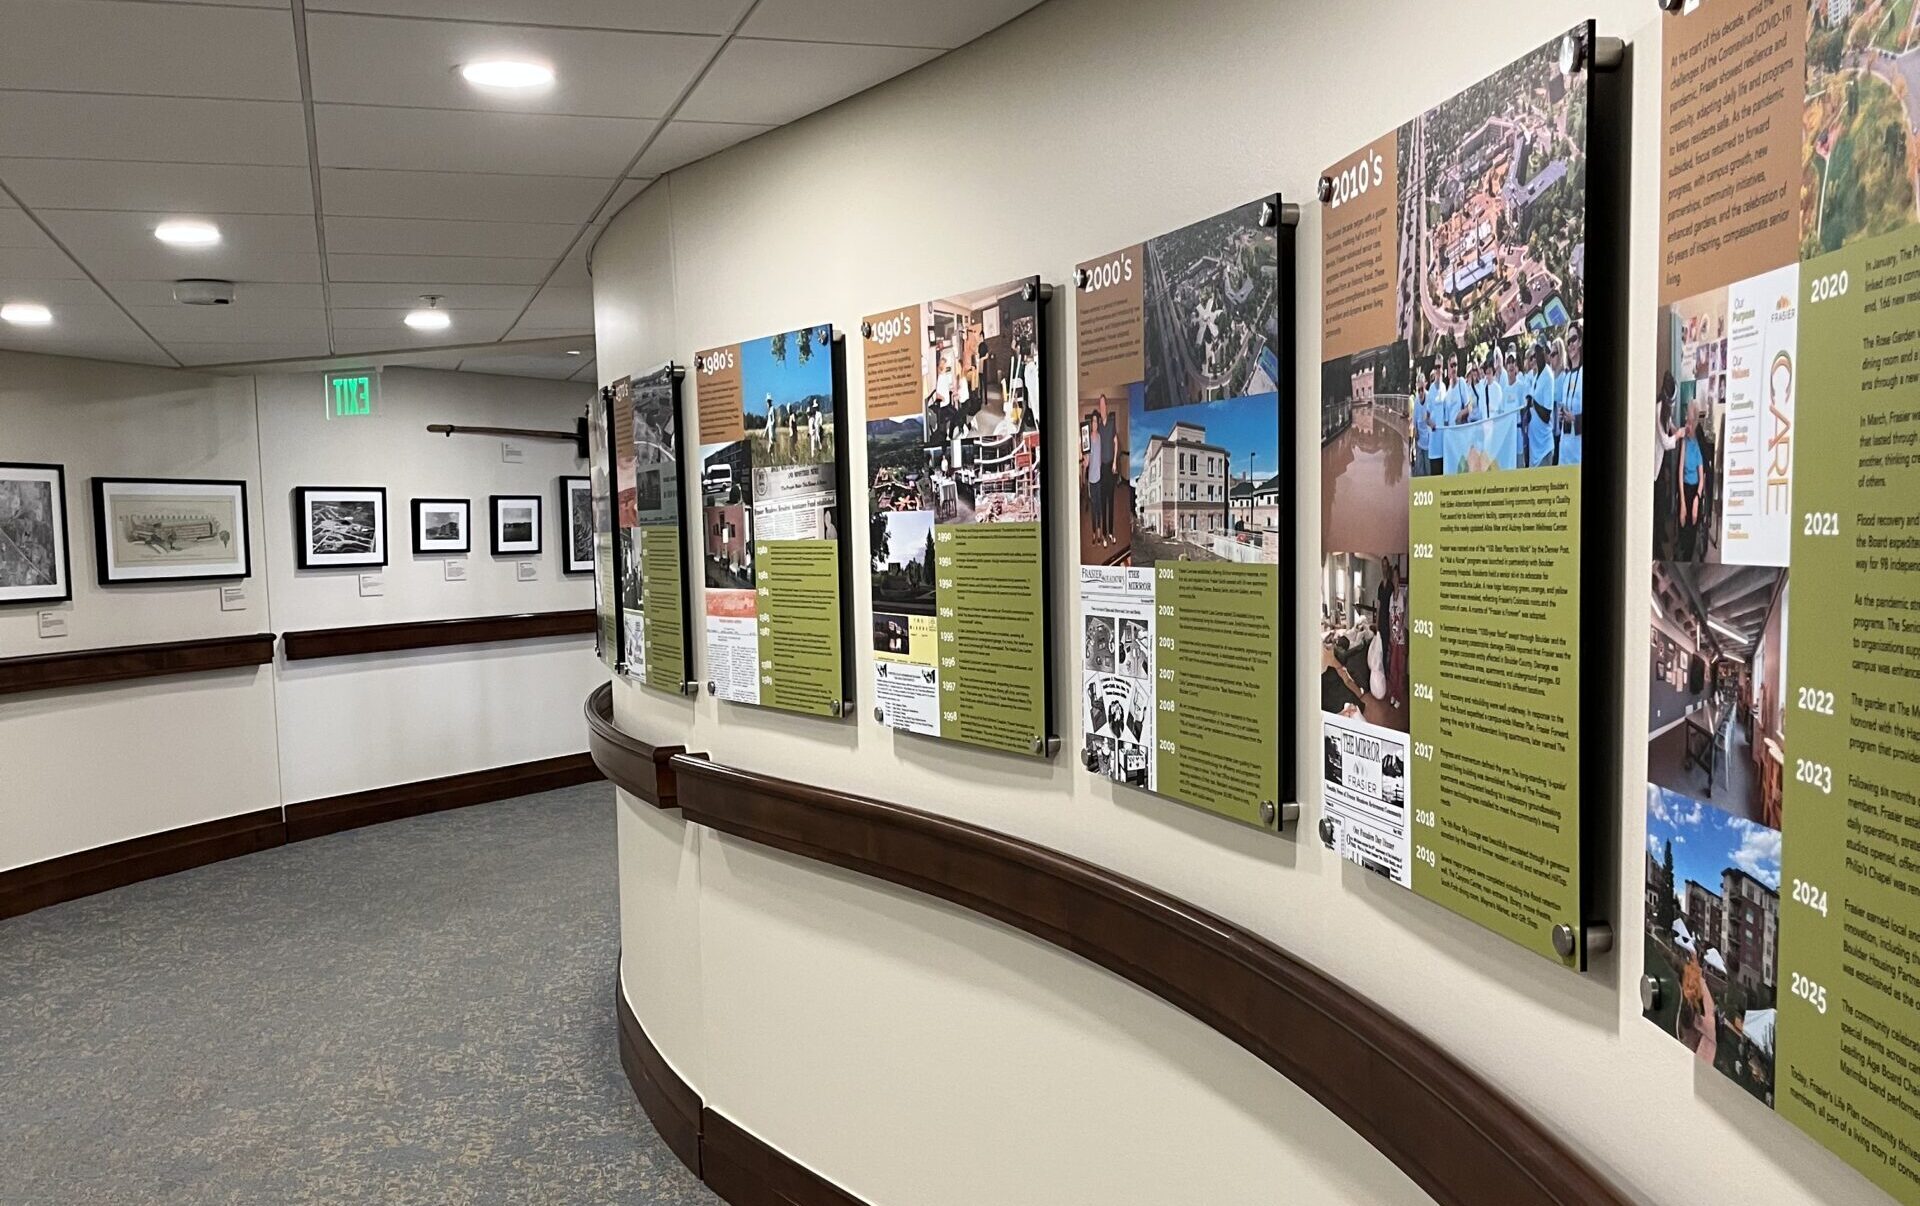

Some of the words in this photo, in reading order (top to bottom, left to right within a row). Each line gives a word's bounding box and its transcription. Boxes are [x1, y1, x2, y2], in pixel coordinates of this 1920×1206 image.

[1332, 149, 1382, 208] 2010's
[1085, 253, 1132, 292] 2000's
[1811, 270, 1848, 303] 2020
[1770, 308, 1795, 323] FRASIER
[872, 312, 911, 344] 1990's
[703, 349, 733, 375] 1980's
[1767, 350, 1792, 515] CARE
[1414, 491, 1433, 506] 2010
[1804, 512, 1839, 535] 2021
[938, 532, 951, 543] 1990
[1414, 544, 1433, 558] 2012
[938, 557, 951, 566] 1991
[1159, 568, 1174, 579] 2001
[939, 578, 952, 589] 1992
[940, 607, 953, 618] 1994
[1159, 605, 1174, 616] 2002
[940, 631, 954, 642] 1995
[1414, 620, 1433, 638] 2013
[1159, 637, 1174, 650] 2003
[942, 657, 955, 668] 1996
[1160, 669, 1174, 682] 2007
[943, 680, 956, 692] 1997
[1414, 683, 1433, 702] 2014
[1160, 700, 1174, 712] 2008
[1798, 687, 1834, 715] 2022
[1160, 740, 1175, 754] 2009
[1343, 733, 1354, 754] THE
[1355, 736, 1381, 763] MIRROR
[1415, 742, 1433, 762] 2017
[1347, 775, 1376, 794] FRASIER
[1796, 758, 1831, 794] 2023
[1416, 808, 1435, 827] 2018
[1416, 844, 1435, 867] 2019
[1793, 879, 1827, 917] 2024
[1791, 972, 1826, 1014] 2025
